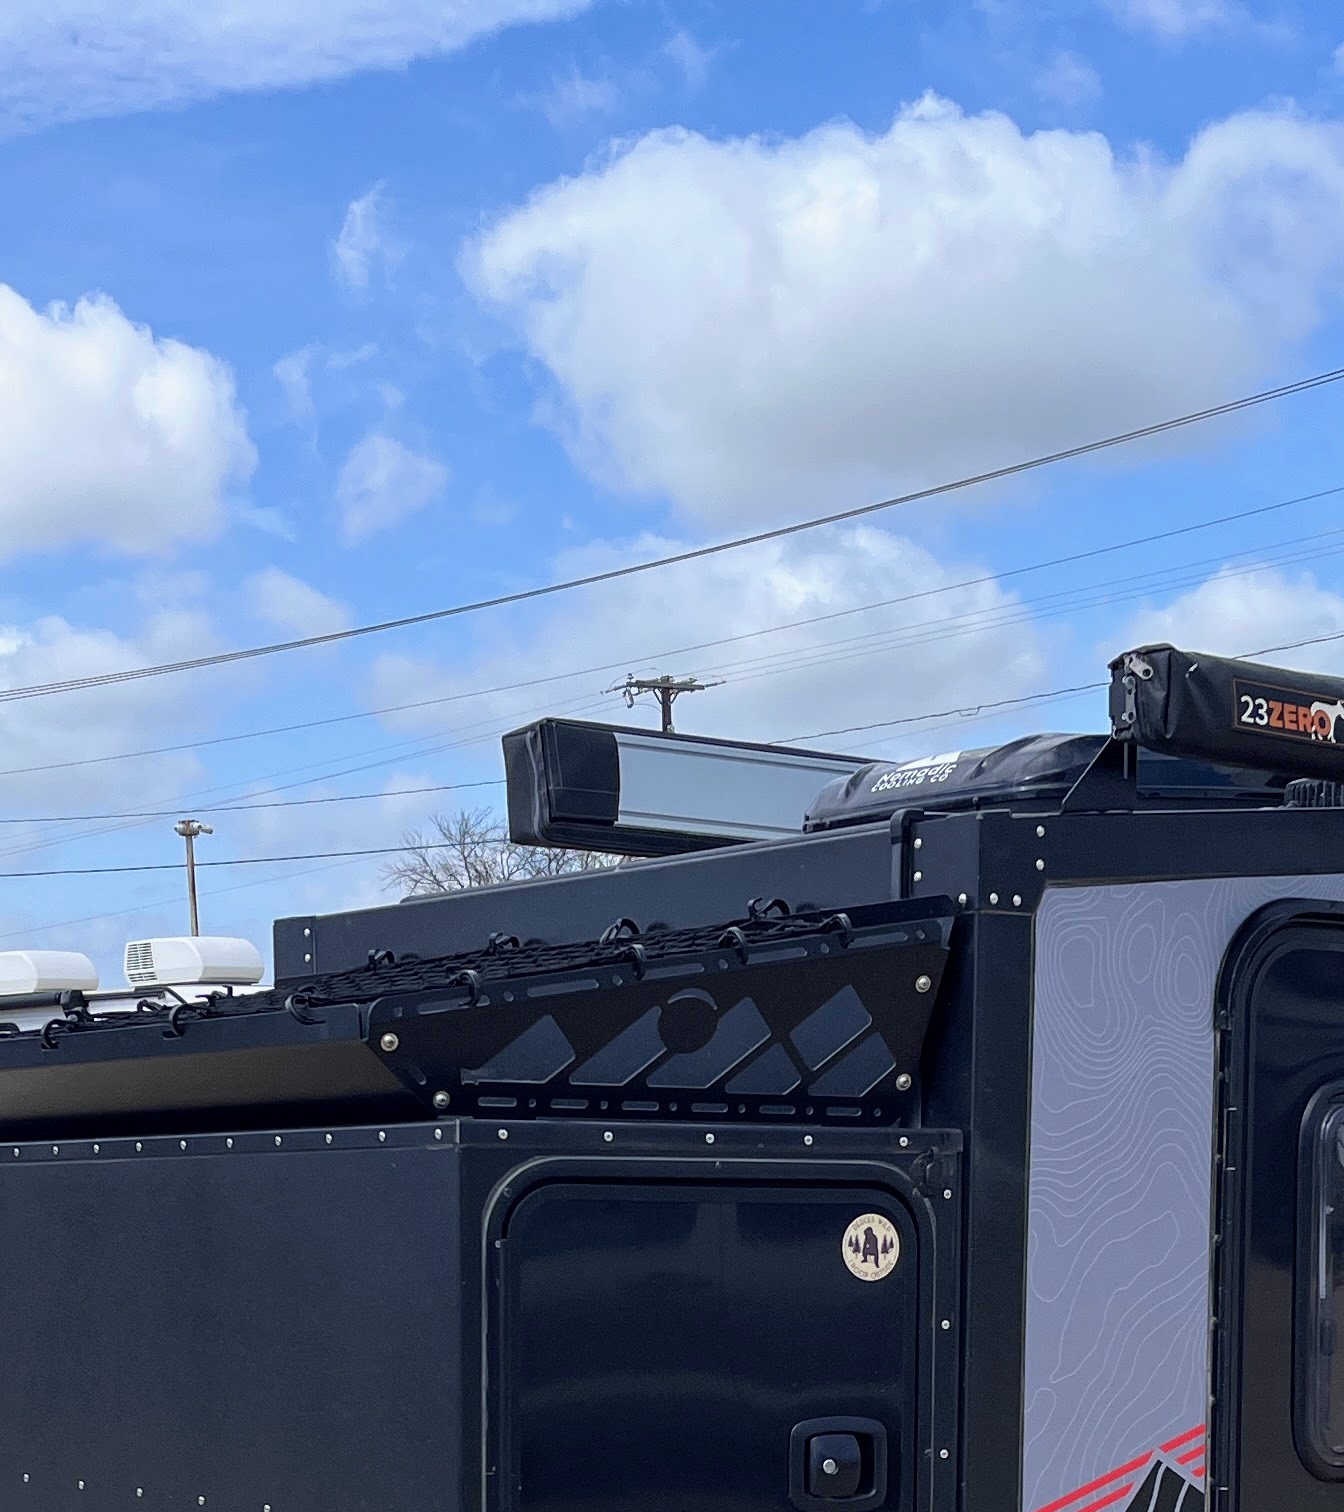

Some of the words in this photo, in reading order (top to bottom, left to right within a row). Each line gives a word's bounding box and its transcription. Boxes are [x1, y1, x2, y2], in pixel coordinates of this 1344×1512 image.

[1240, 695, 1332, 737] 23ZERO
[871, 776, 926, 793] COOLING
[929, 773, 949, 783] CO
[875, 763, 957, 785] Nomadic
